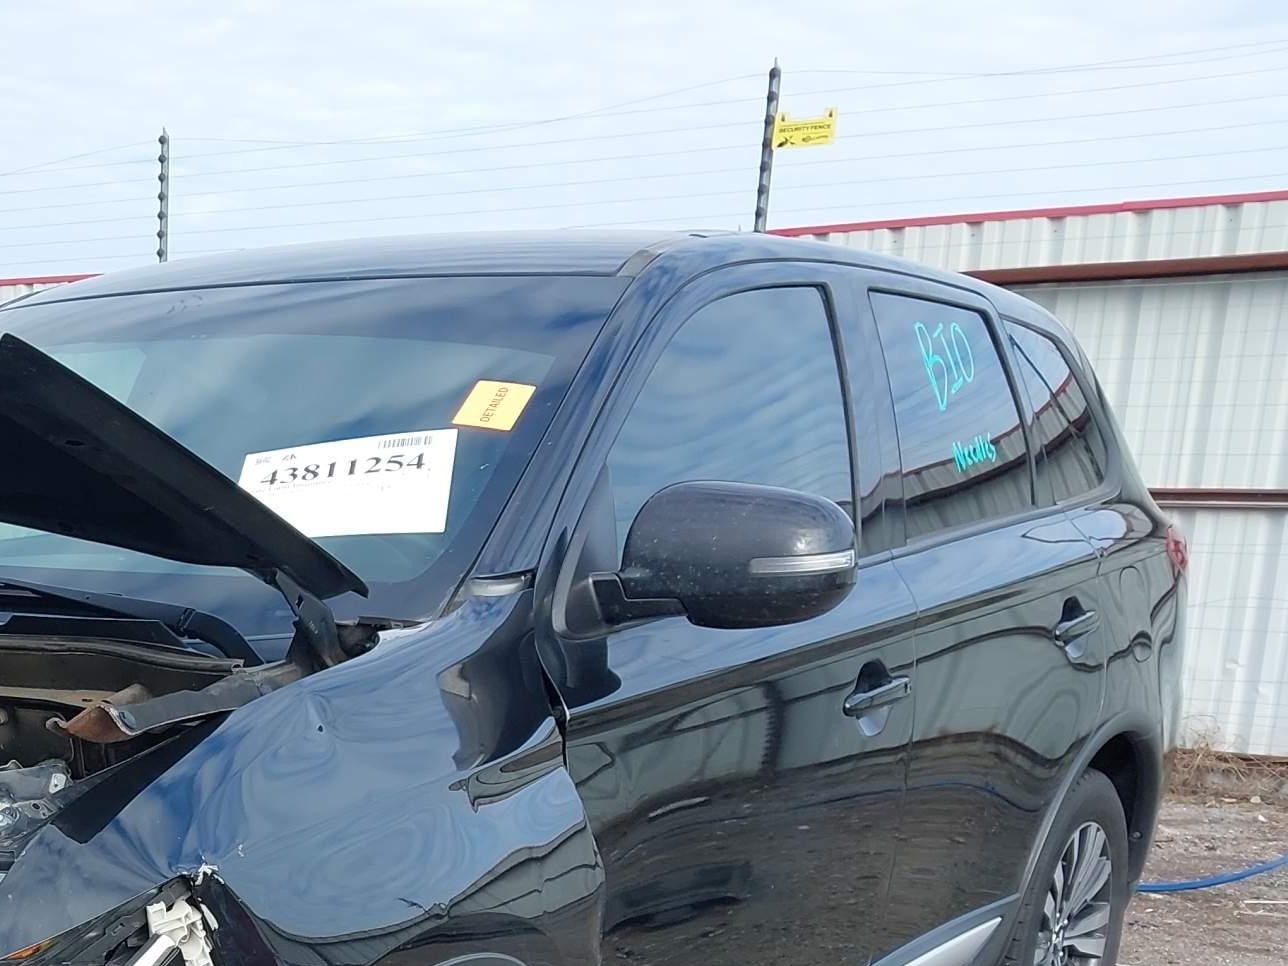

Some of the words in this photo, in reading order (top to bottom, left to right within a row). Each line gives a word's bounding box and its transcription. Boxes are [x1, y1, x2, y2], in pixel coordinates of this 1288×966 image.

[914, 321, 975, 413] BIO
[479, 386, 509, 423] DETAILED
[260, 452, 426, 486] 43811254
